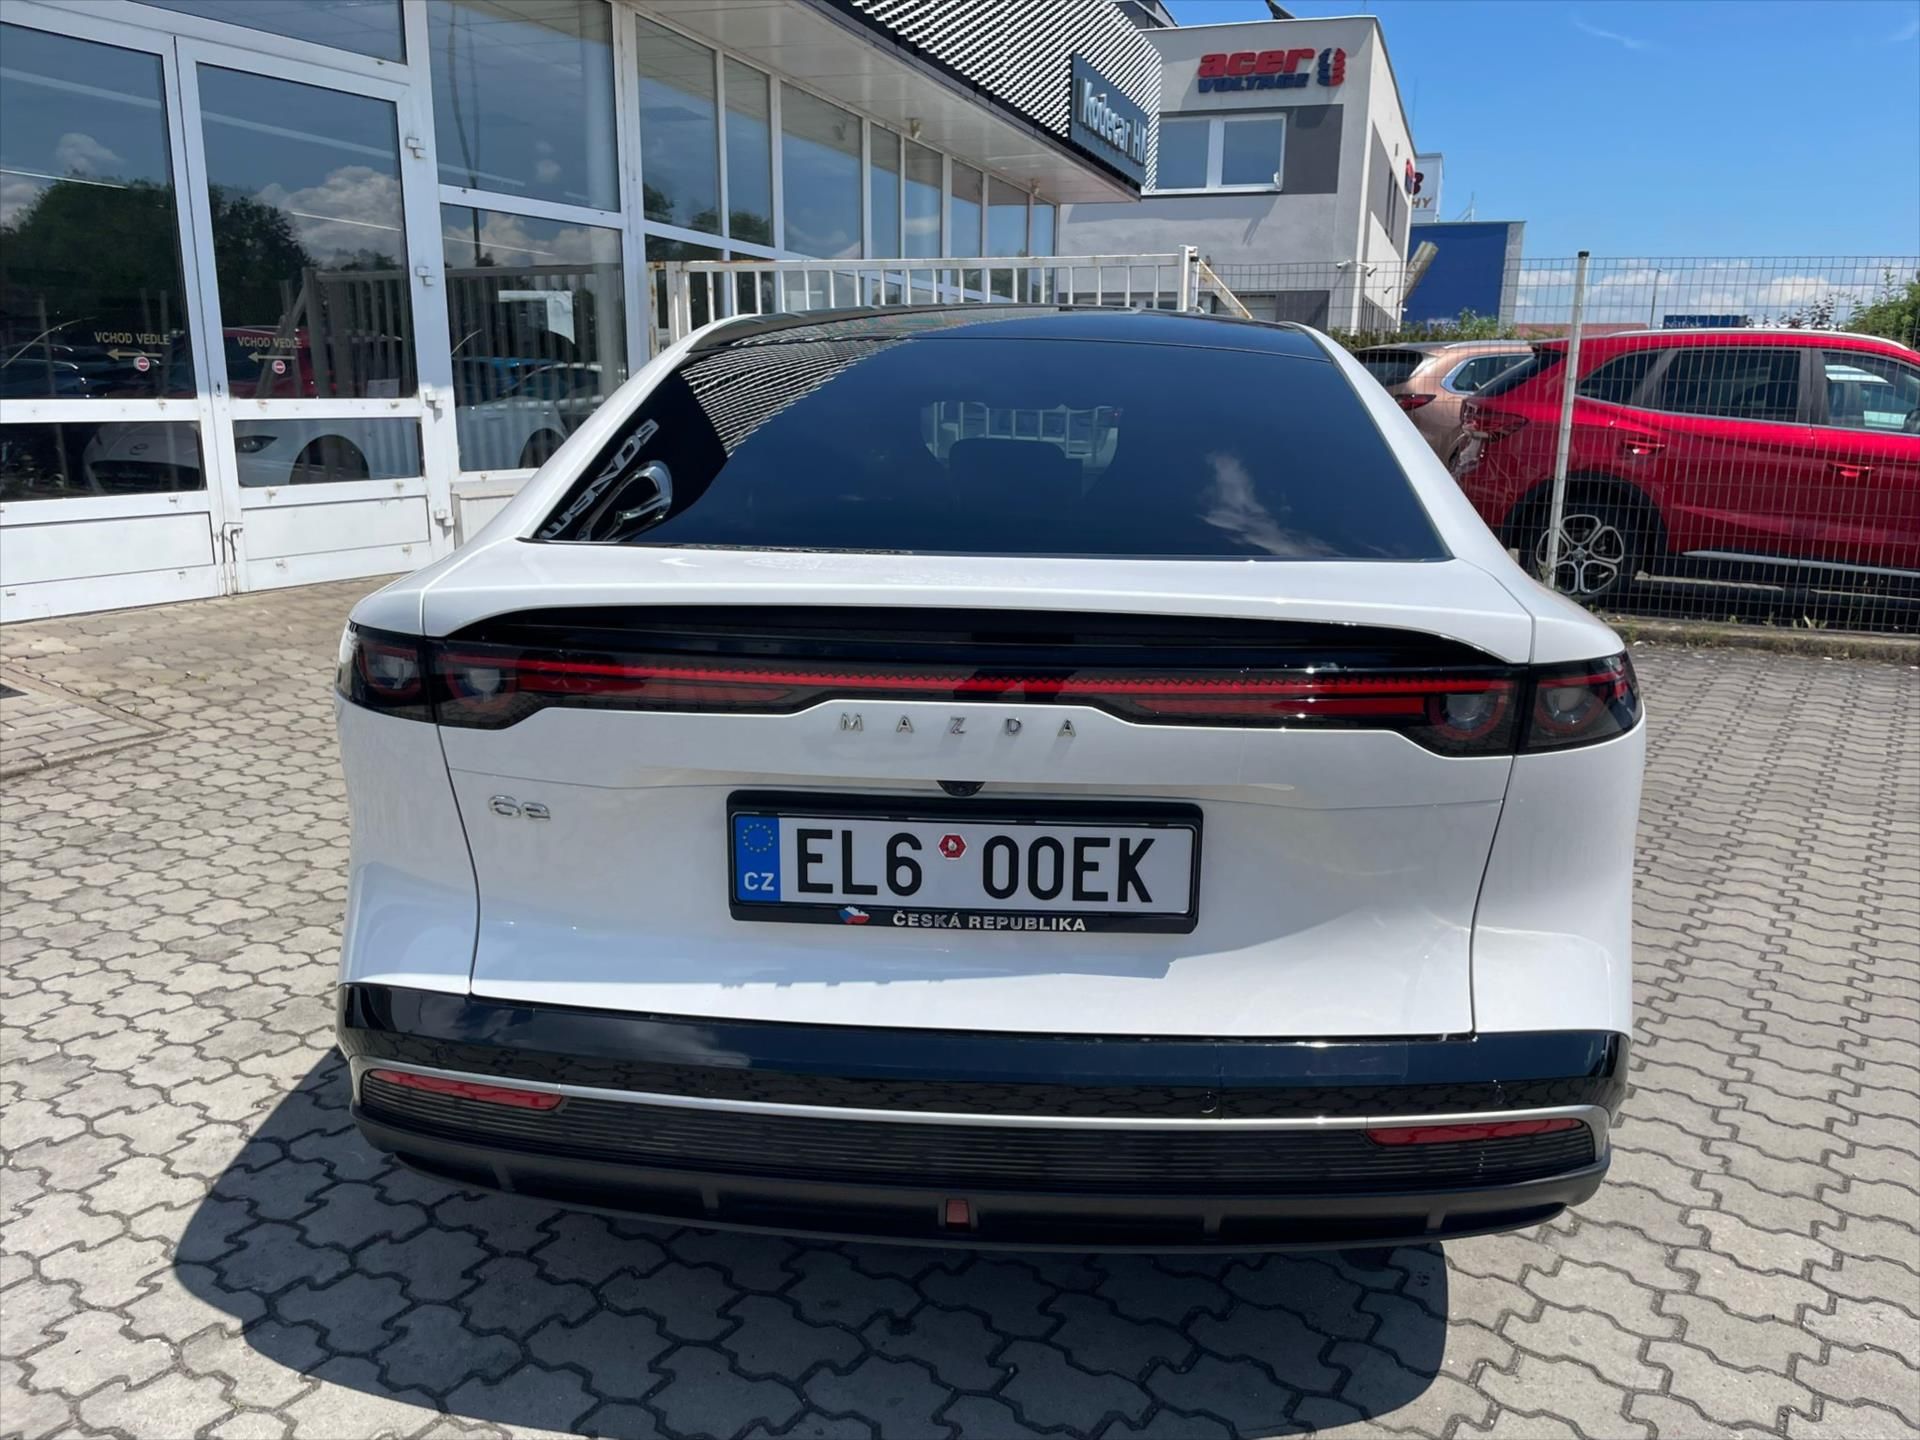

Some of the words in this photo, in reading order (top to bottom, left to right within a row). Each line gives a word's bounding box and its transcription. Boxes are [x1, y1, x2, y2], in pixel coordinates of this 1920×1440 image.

[1198, 48, 1316, 77] acer
[94, 331, 132, 344] VCHOD
[136, 333, 170, 345] VEDLE
[237, 336, 270, 347] VCHOD
[272, 337, 303, 348] VEDLE
[839, 712, 1077, 738] MAZDA
[797, 828, 923, 897] EL6
[743, 872, 775, 891] CZ
[892, 910, 961, 929] ČESKÁ
[968, 914, 1086, 932] REPUBLIKA
